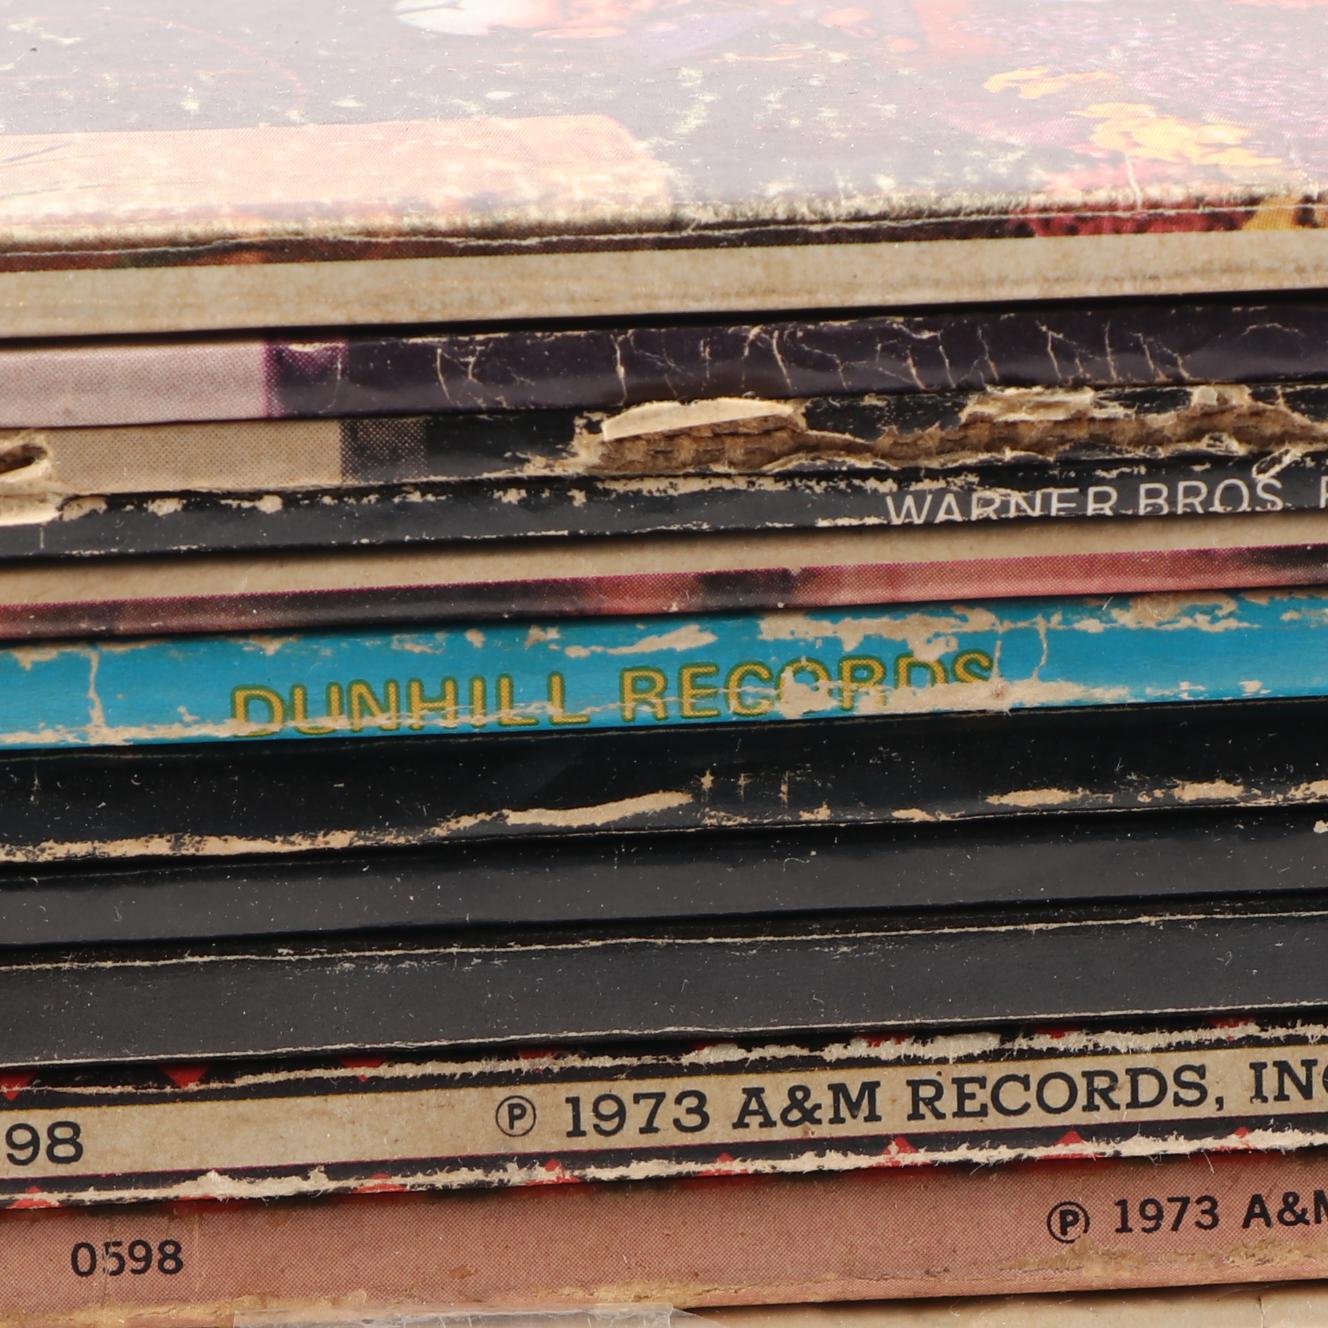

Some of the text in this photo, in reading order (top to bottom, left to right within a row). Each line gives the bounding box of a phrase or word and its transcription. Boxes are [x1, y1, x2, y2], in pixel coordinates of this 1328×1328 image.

[885, 485, 1119, 525] WARNER
[231, 650, 996, 737] DUNHILL RECORDS
[564, 1090, 711, 1138] 1973
[732, 1081, 882, 1130] A&M
[906, 1063, 1225, 1122] RECORDS,
[70, 1239, 185, 1278] 0598
[1114, 1195, 1220, 1235] 1973
